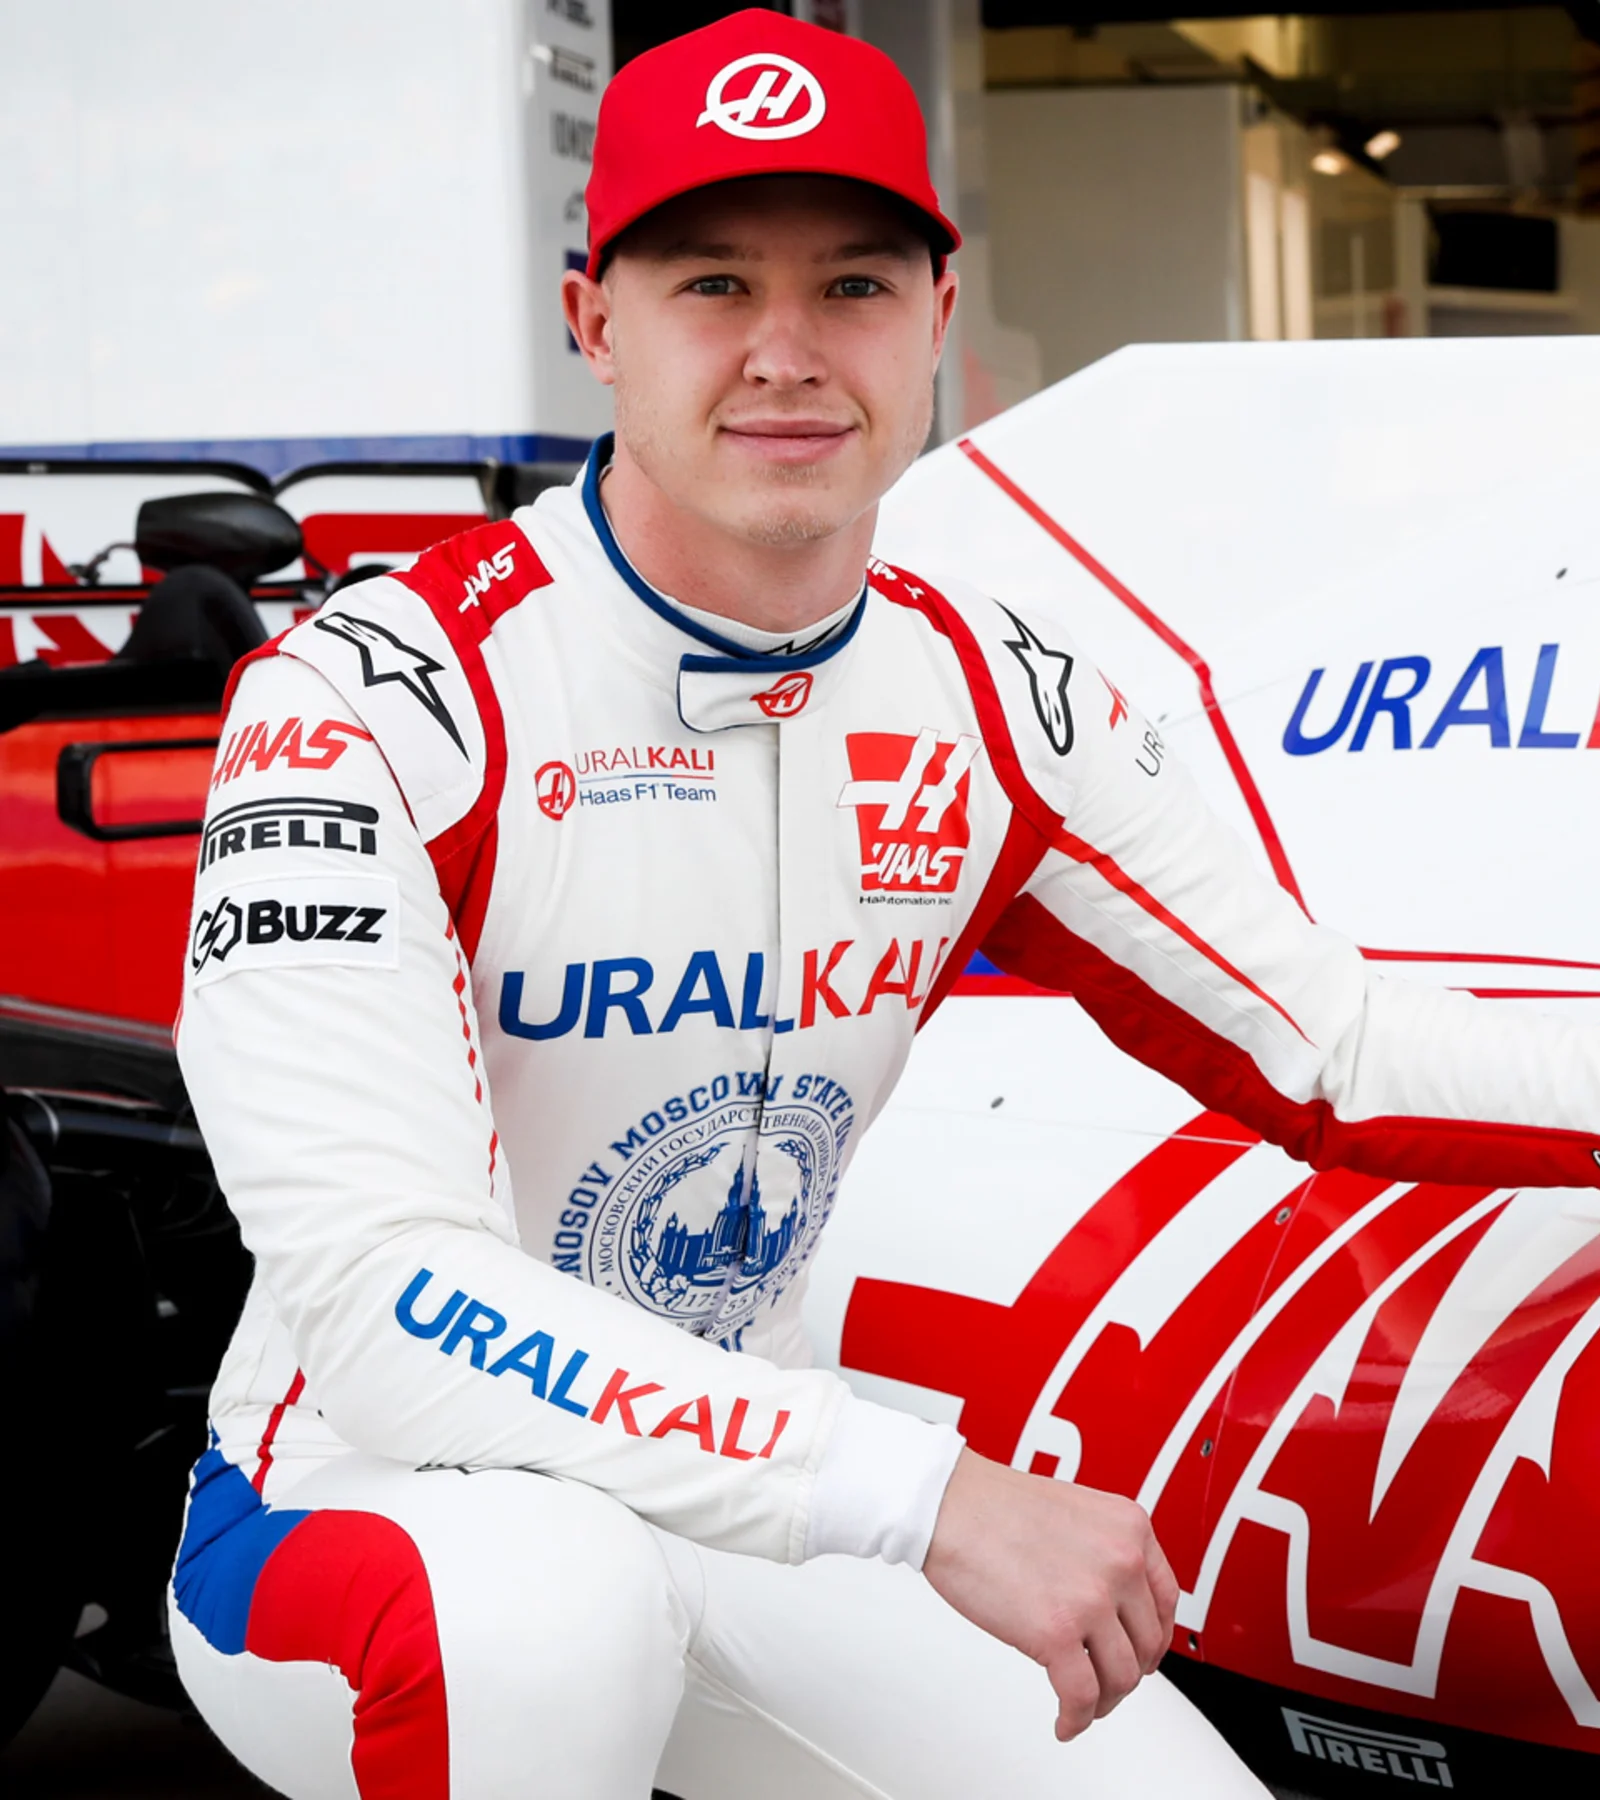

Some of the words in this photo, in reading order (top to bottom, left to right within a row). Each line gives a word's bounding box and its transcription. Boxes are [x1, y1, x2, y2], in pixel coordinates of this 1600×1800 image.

[459, 542, 516, 614] HAAS
[211, 717, 373, 791] HAAS
[575, 746, 715, 775] URALKALI
[579, 788, 632, 806] Haas
[664, 783, 717, 802] Team
[200, 797, 379, 875] PIRELLI
[552, 1160, 613, 1276] NOSOV
[609, 1071, 783, 1161] MOSCOW
[792, 1074, 854, 1121] STATE
[394, 1267, 791, 1461] URALKALI
[1281, 1707, 1453, 1788] PIRELLI
